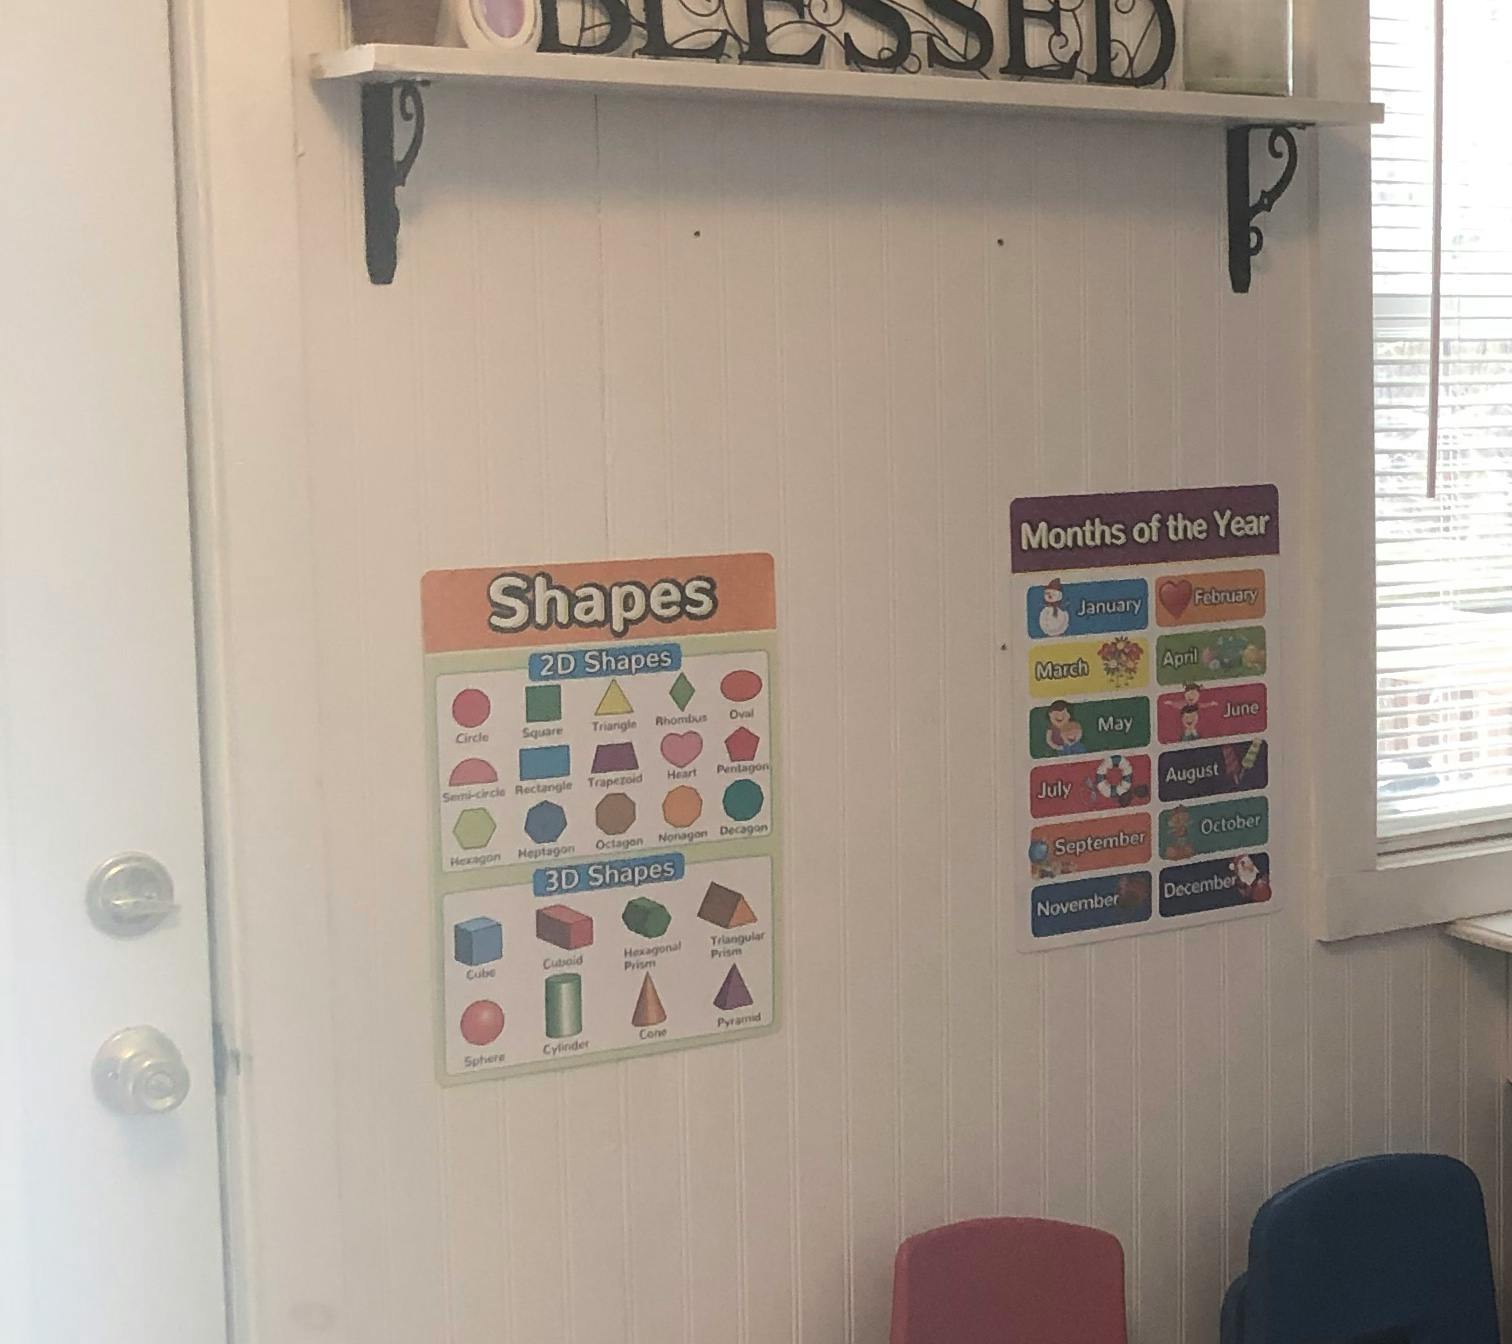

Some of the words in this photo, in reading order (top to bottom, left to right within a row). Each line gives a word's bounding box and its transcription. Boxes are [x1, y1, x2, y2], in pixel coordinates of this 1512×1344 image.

[1021, 518, 1126, 552] Months
[1132, 515, 1161, 544] of
[1166, 513, 1207, 540] the
[1213, 510, 1270, 539] Year
[487, 572, 718, 637] Shapes
[1194, 588, 1258, 605] February
[1077, 597, 1142, 616] January
[539, 655, 576, 678] 2D
[584, 650, 672, 675] Shapes
[1162, 648, 1199, 667] April
[1034, 658, 1089, 680] March
[728, 707, 754, 720] Oval
[1222, 700, 1260, 717] June
[592, 718, 637, 734] Triangle
[655, 712, 708, 726] Rhombus
[1097, 714, 1134, 734] May
[455, 732, 489, 744] Circle
[522, 726, 564, 739] Square
[666, 767, 697, 780] Heart
[716, 761, 770, 776] Pentagon
[1164, 763, 1219, 784] August
[515, 780, 573, 795] Rectangle
[587, 773, 643, 789] Trapezoid
[1037, 780, 1072, 800] July
[719, 822, 768, 837] Decagon
[1199, 813, 1262, 836] October
[595, 836, 643, 850] Octagon
[657, 828, 708, 843] Nonagon
[1054, 830, 1146, 857] September
[449, 852, 501, 867] Hexagon
[517, 843, 575, 860] Heptagon
[543, 869, 580, 893] 3D
[588, 860, 676, 887] Shapes
[1164, 874, 1238, 899] December
[1036, 891, 1120, 917] November
[710, 931, 765, 946] Triangular
[623, 942, 682, 959] Hexagonal
[710, 945, 743, 959] Prism
[543, 955, 584, 970] Cuboid
[623, 957, 656, 971] Prism
[466, 967, 496, 980] Cube
[717, 1012, 761, 1029] Pyramid
[639, 1028, 667, 1040] Cone
[542, 1039, 589, 1057] Cylinder
[463, 1053, 506, 1068] Sphere
